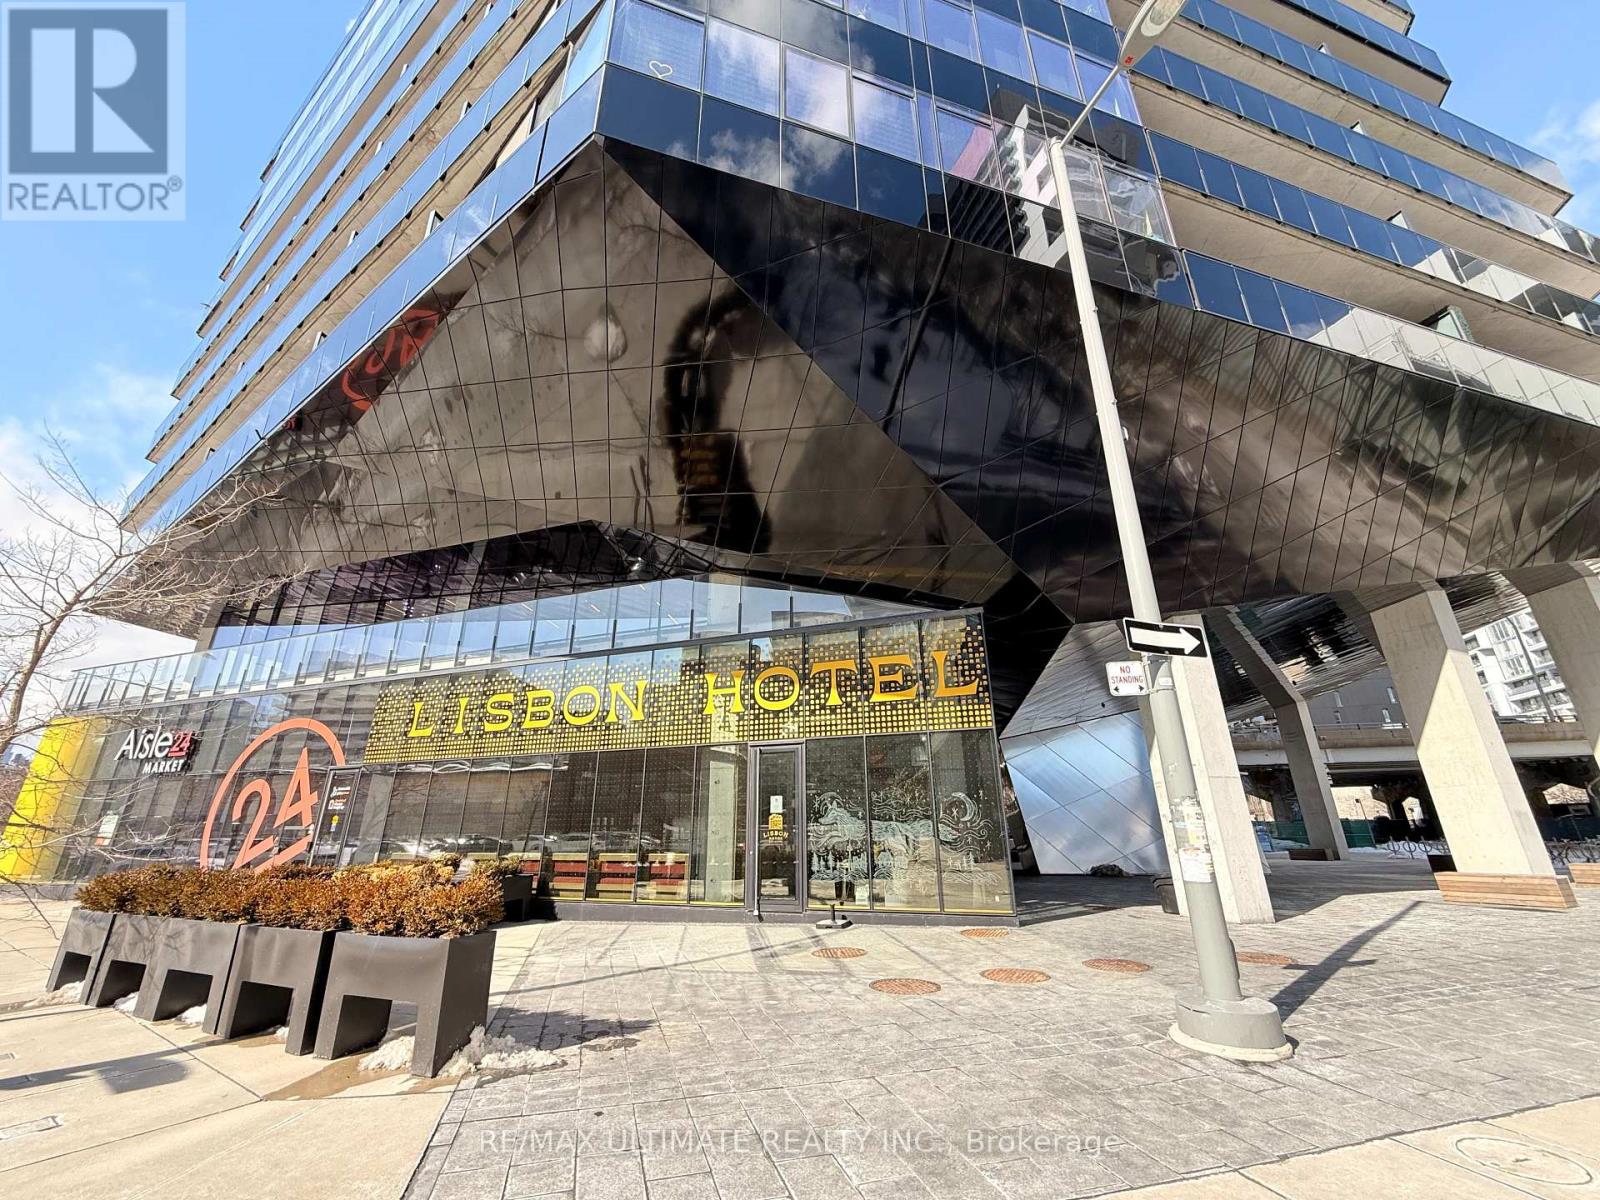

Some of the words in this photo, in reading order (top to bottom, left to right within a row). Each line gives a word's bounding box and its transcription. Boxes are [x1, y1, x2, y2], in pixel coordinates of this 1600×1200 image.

[1119, 665, 1131, 674] NO
[1111, 675, 1144, 684] STANDING
[407, 680, 648, 738] LISBON
[703, 650, 980, 715] HOTEL
[142, 760, 185, 774] MARKET
[231, 747, 318, 870] 24
[763, 830, 789, 839] LISBON
